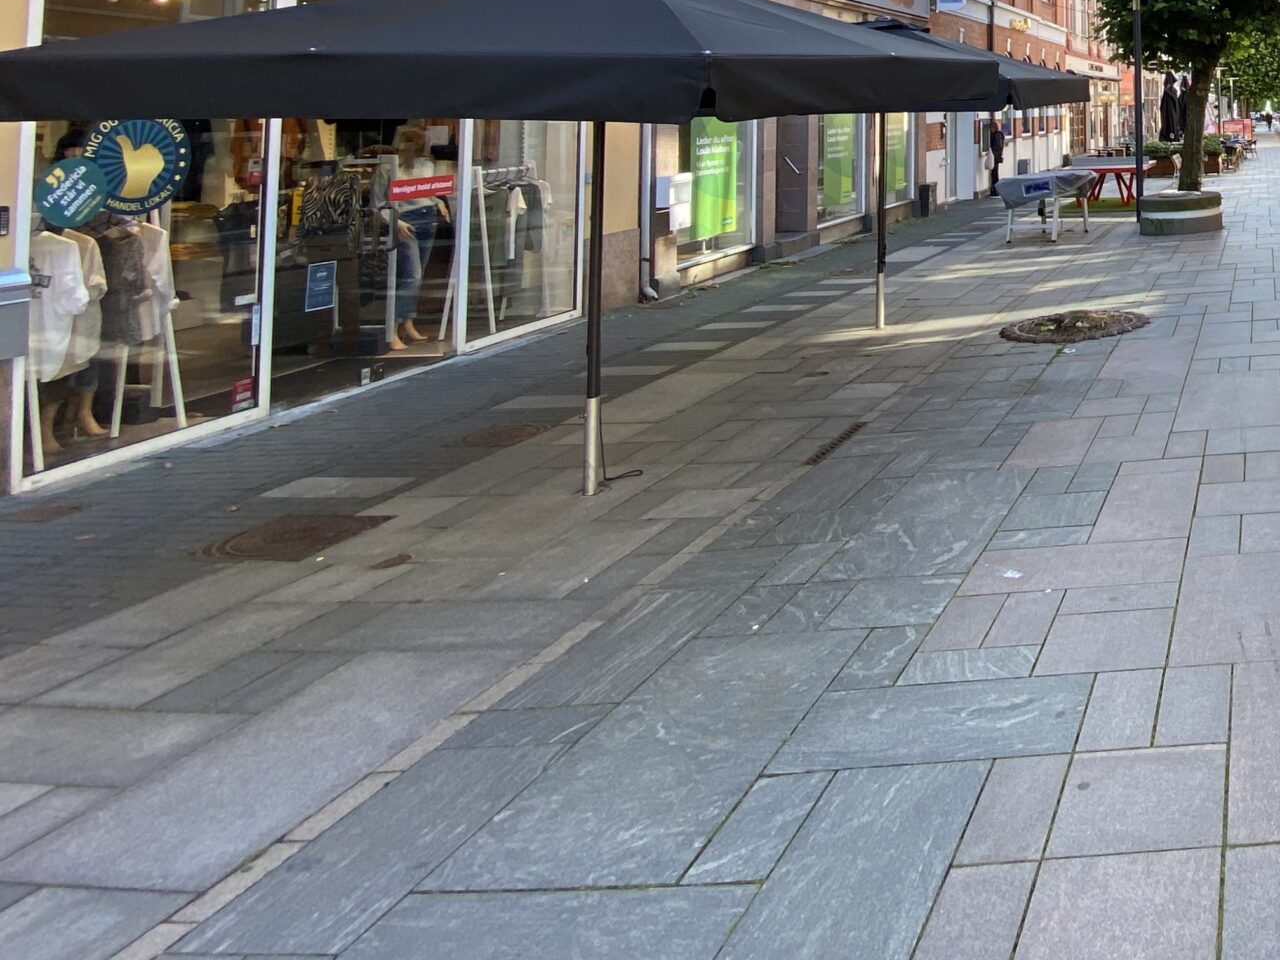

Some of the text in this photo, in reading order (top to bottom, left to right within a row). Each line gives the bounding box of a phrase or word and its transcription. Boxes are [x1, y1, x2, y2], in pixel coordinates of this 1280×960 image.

[84, 132, 103, 158] MIG
[47, 166, 87, 204] Fredericia
[106, 197, 143, 211] HANDEL
[144, 183, 174, 209] LOKALT
[64, 184, 97, 217] sammen
